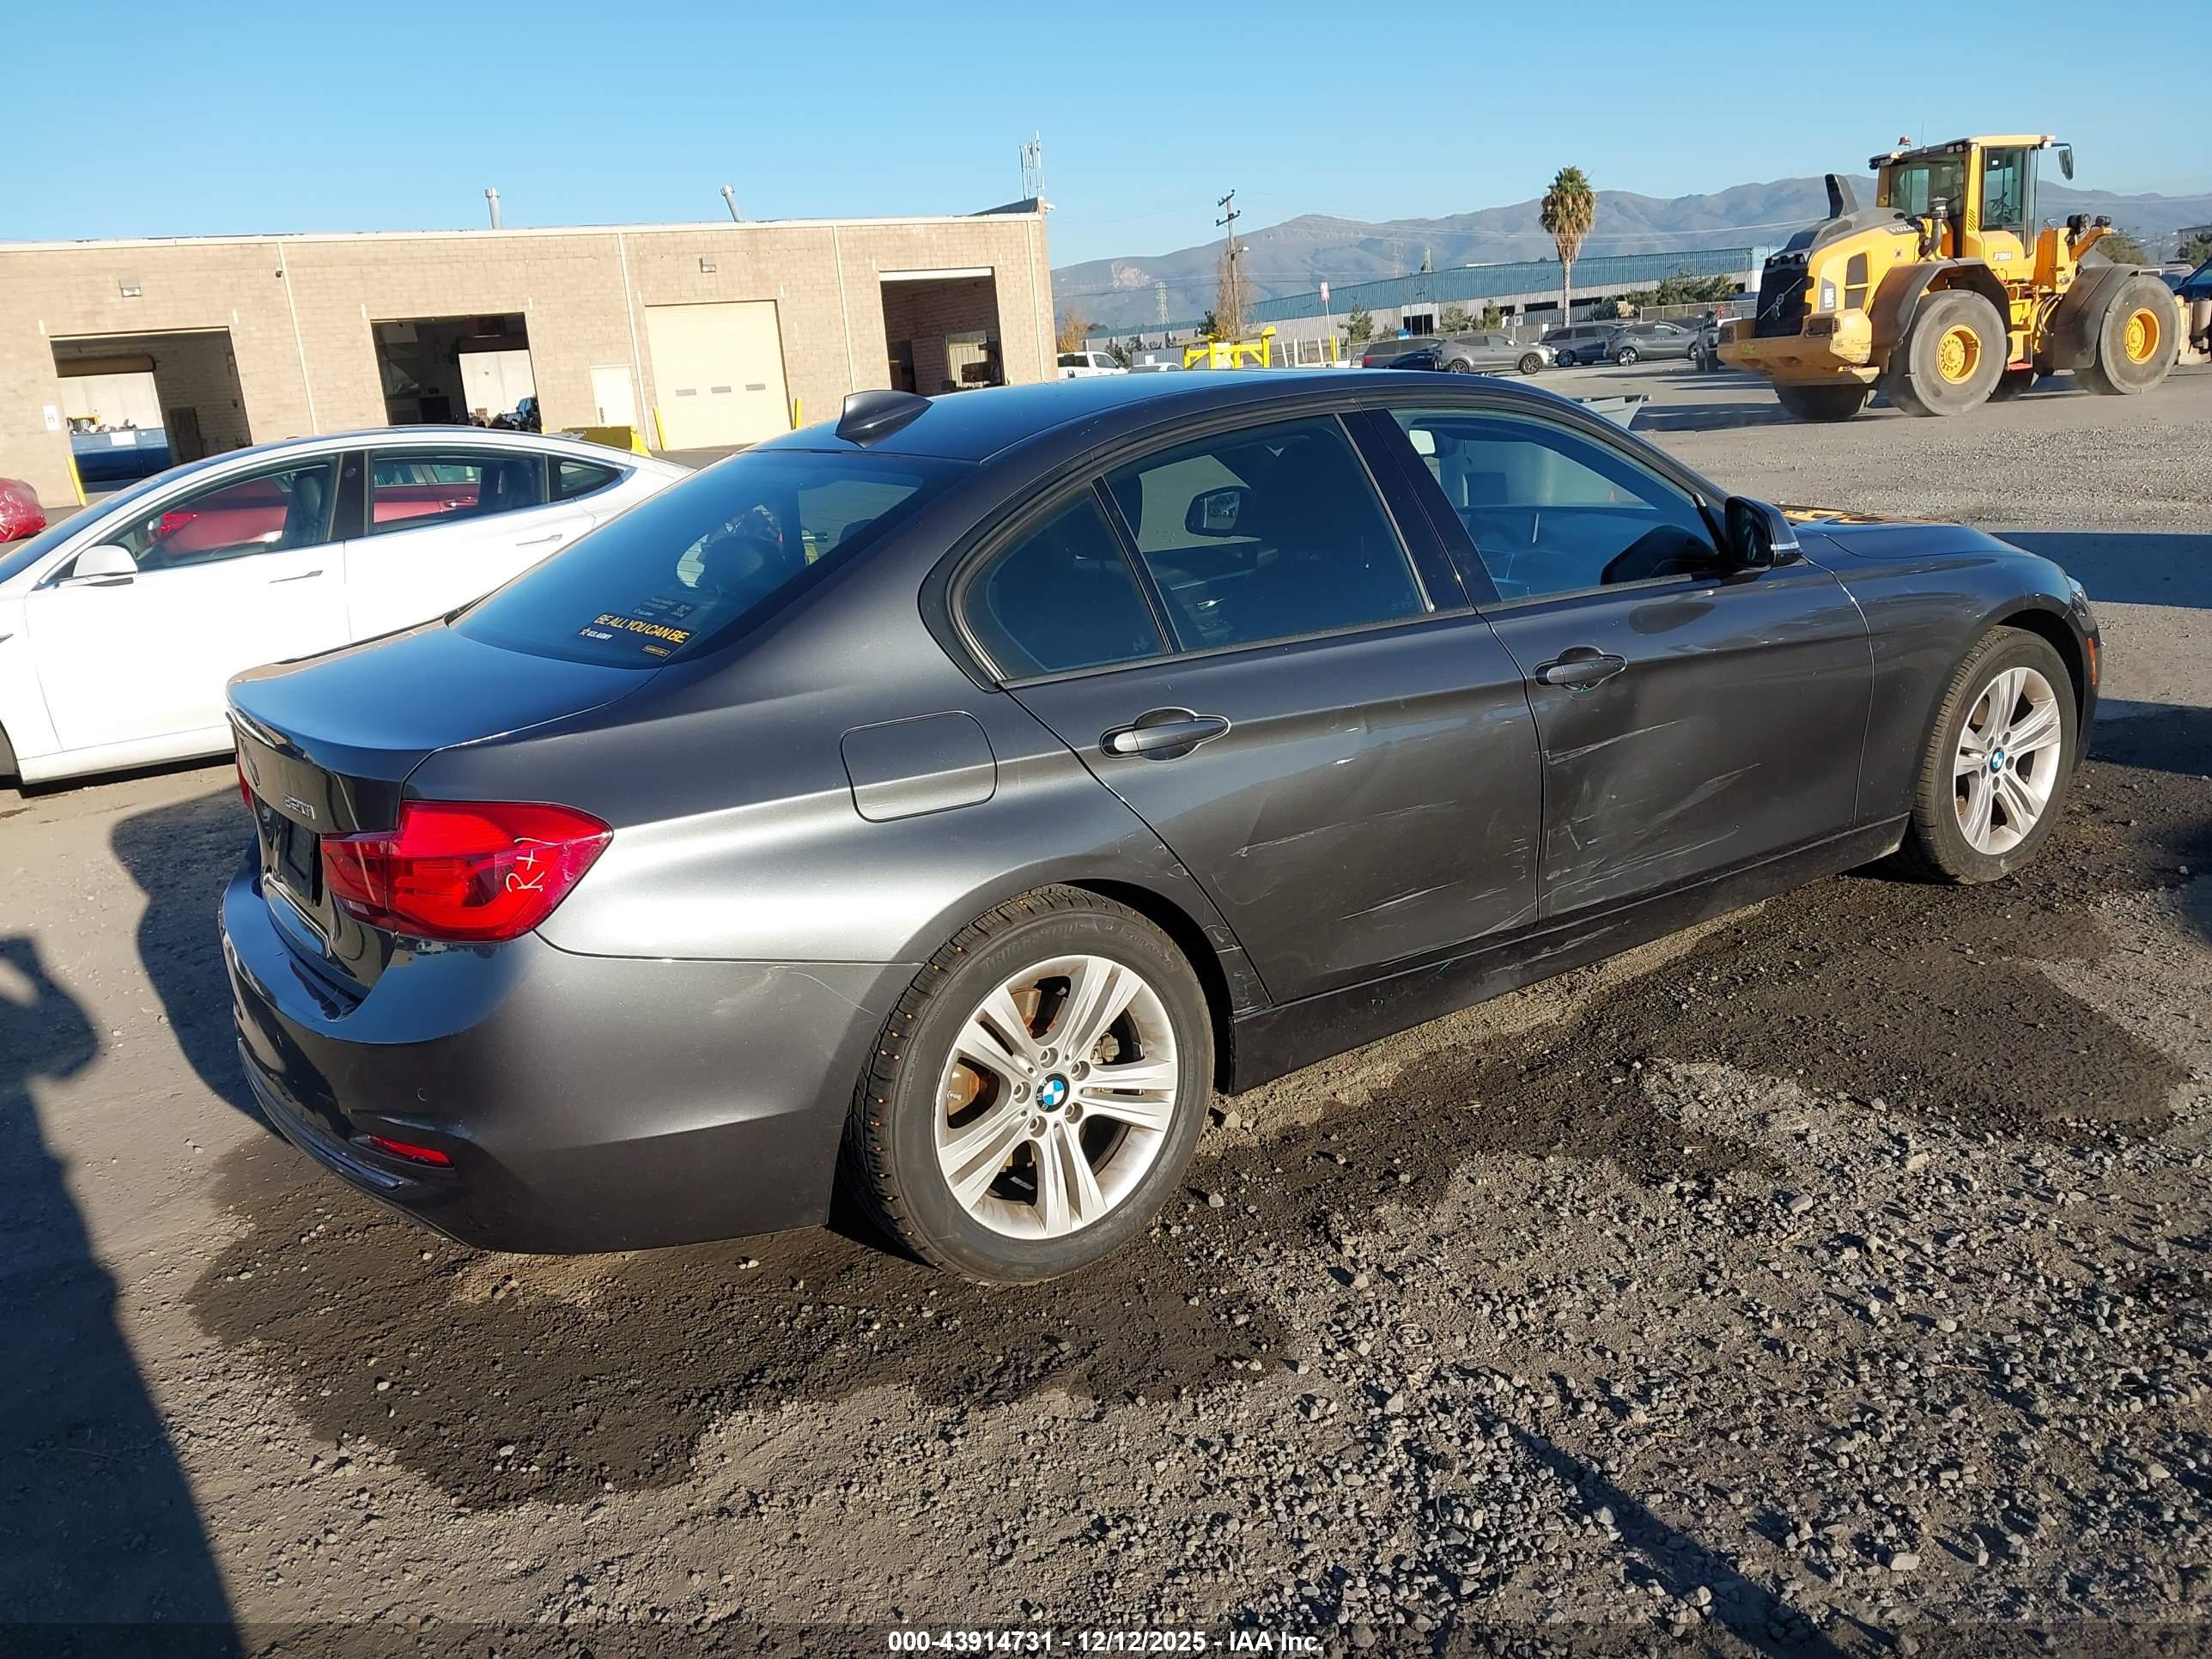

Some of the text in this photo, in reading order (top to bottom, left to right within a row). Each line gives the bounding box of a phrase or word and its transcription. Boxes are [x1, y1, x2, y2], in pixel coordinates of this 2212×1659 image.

[593, 614, 614, 625] BE
[606, 617, 629, 629] ALL
[625, 619, 649, 633] YOU
[645, 624, 673, 639] CAN
